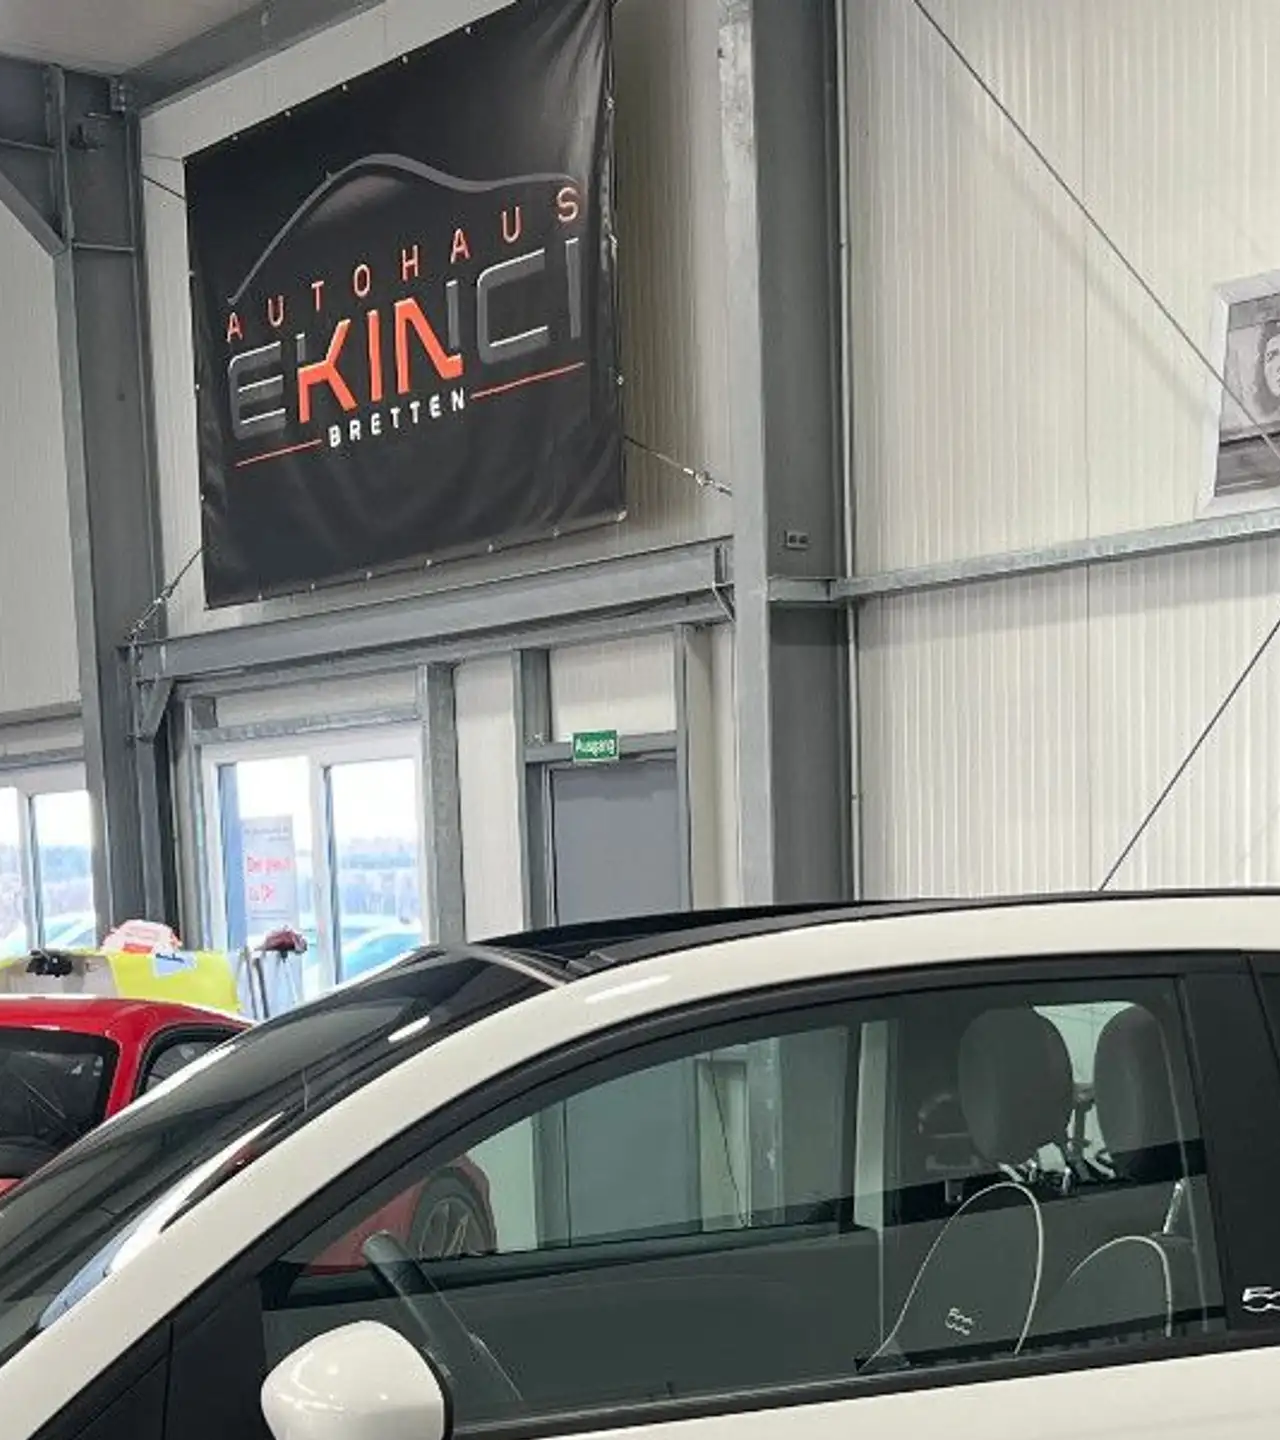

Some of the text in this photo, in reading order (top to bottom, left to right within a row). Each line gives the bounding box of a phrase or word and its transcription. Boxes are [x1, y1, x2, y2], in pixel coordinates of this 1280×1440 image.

[226, 186, 581, 342] AUTOHAUS
[228, 236, 582, 440] EKINCI
[328, 387, 465, 449] BRETTEN
